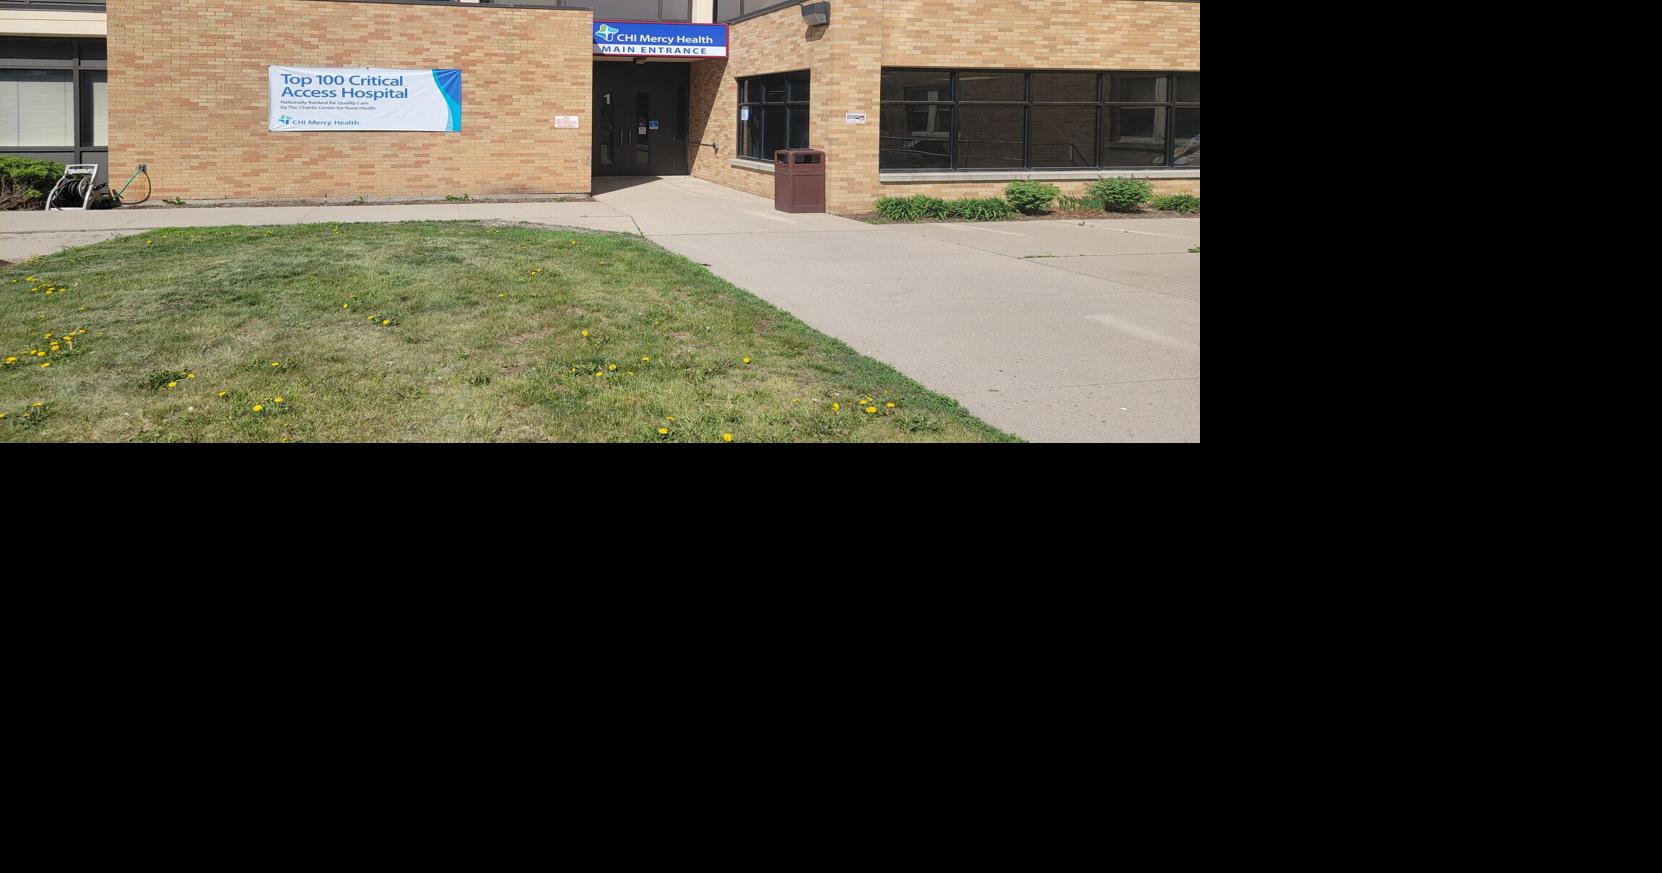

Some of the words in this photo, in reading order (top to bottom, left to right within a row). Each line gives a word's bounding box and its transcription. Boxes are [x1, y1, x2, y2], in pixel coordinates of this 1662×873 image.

[617, 34, 637, 42] CHI
[640, 35, 674, 44] Mercy
[676, 35, 713, 44] Health
[601, 45, 635, 53] MAIN
[640, 46, 707, 54] ENTRANCE
[280, 73, 313, 87] Top
[316, 74, 345, 86] 100
[348, 74, 403, 87] Critical
[281, 87, 337, 98] Access
[341, 87, 409, 101] Hospital
[603, 93, 611, 105] 1
